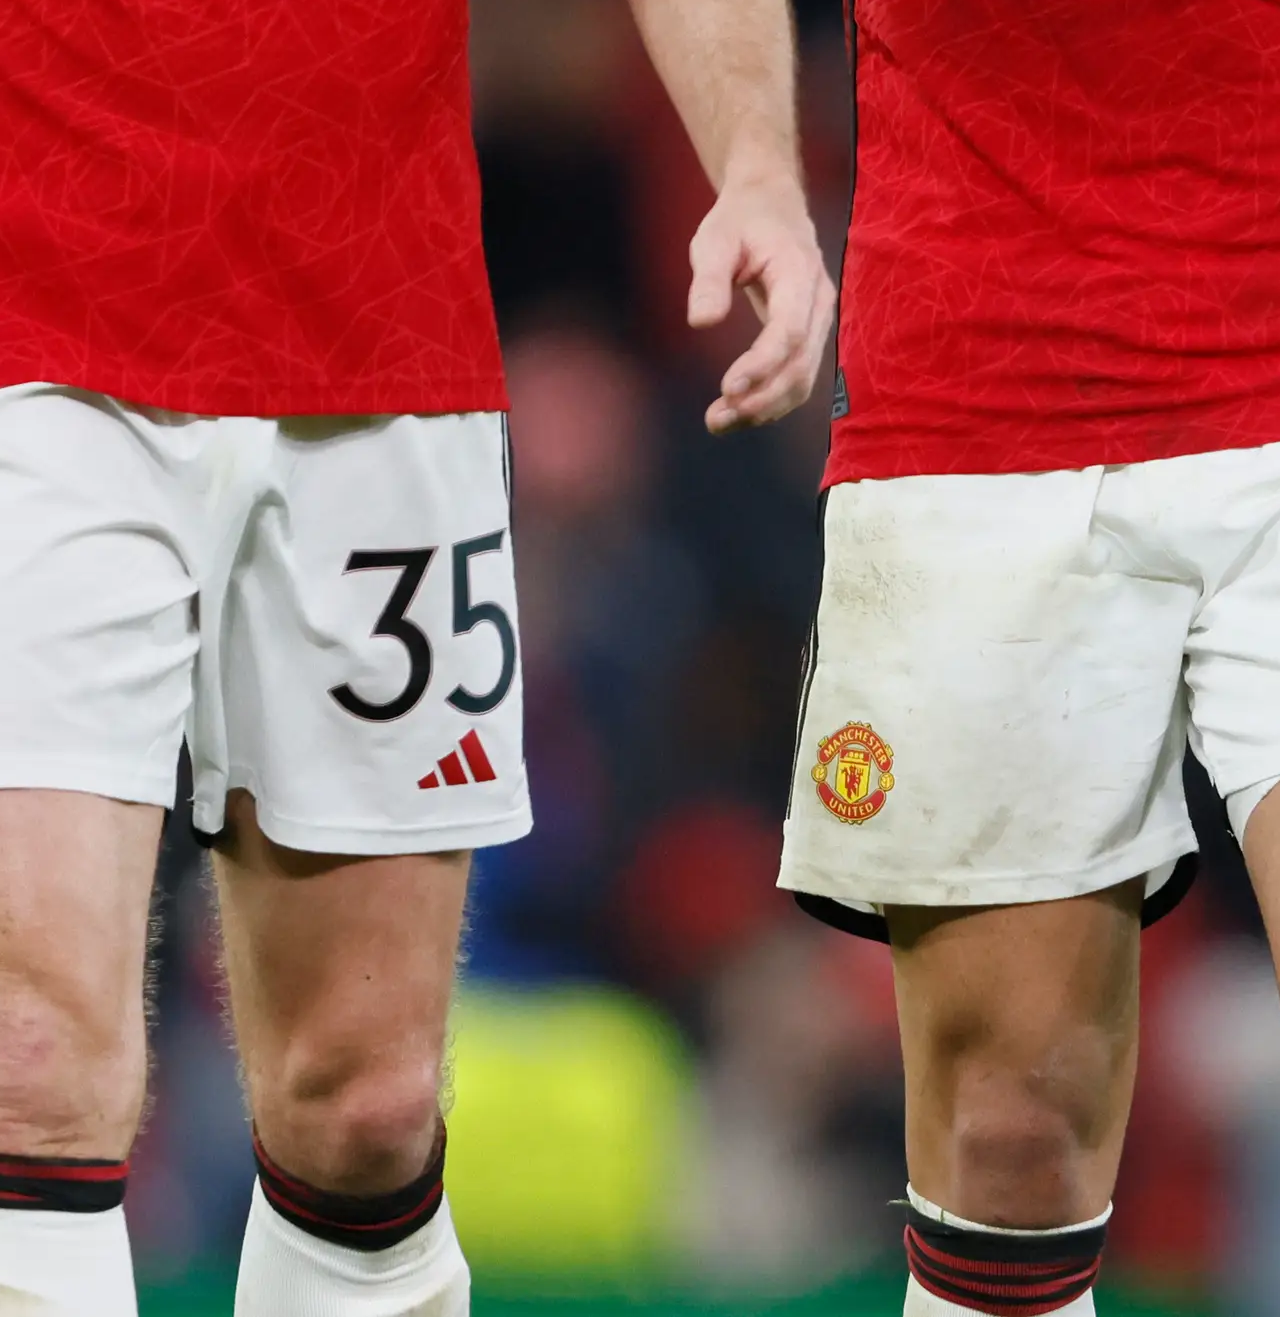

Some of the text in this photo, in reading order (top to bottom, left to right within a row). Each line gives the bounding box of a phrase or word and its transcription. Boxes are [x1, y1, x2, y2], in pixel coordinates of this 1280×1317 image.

[327, 527, 517, 724] 35
[823, 728, 888, 767] MANCHESTER
[829, 797, 874, 817] UNITED
